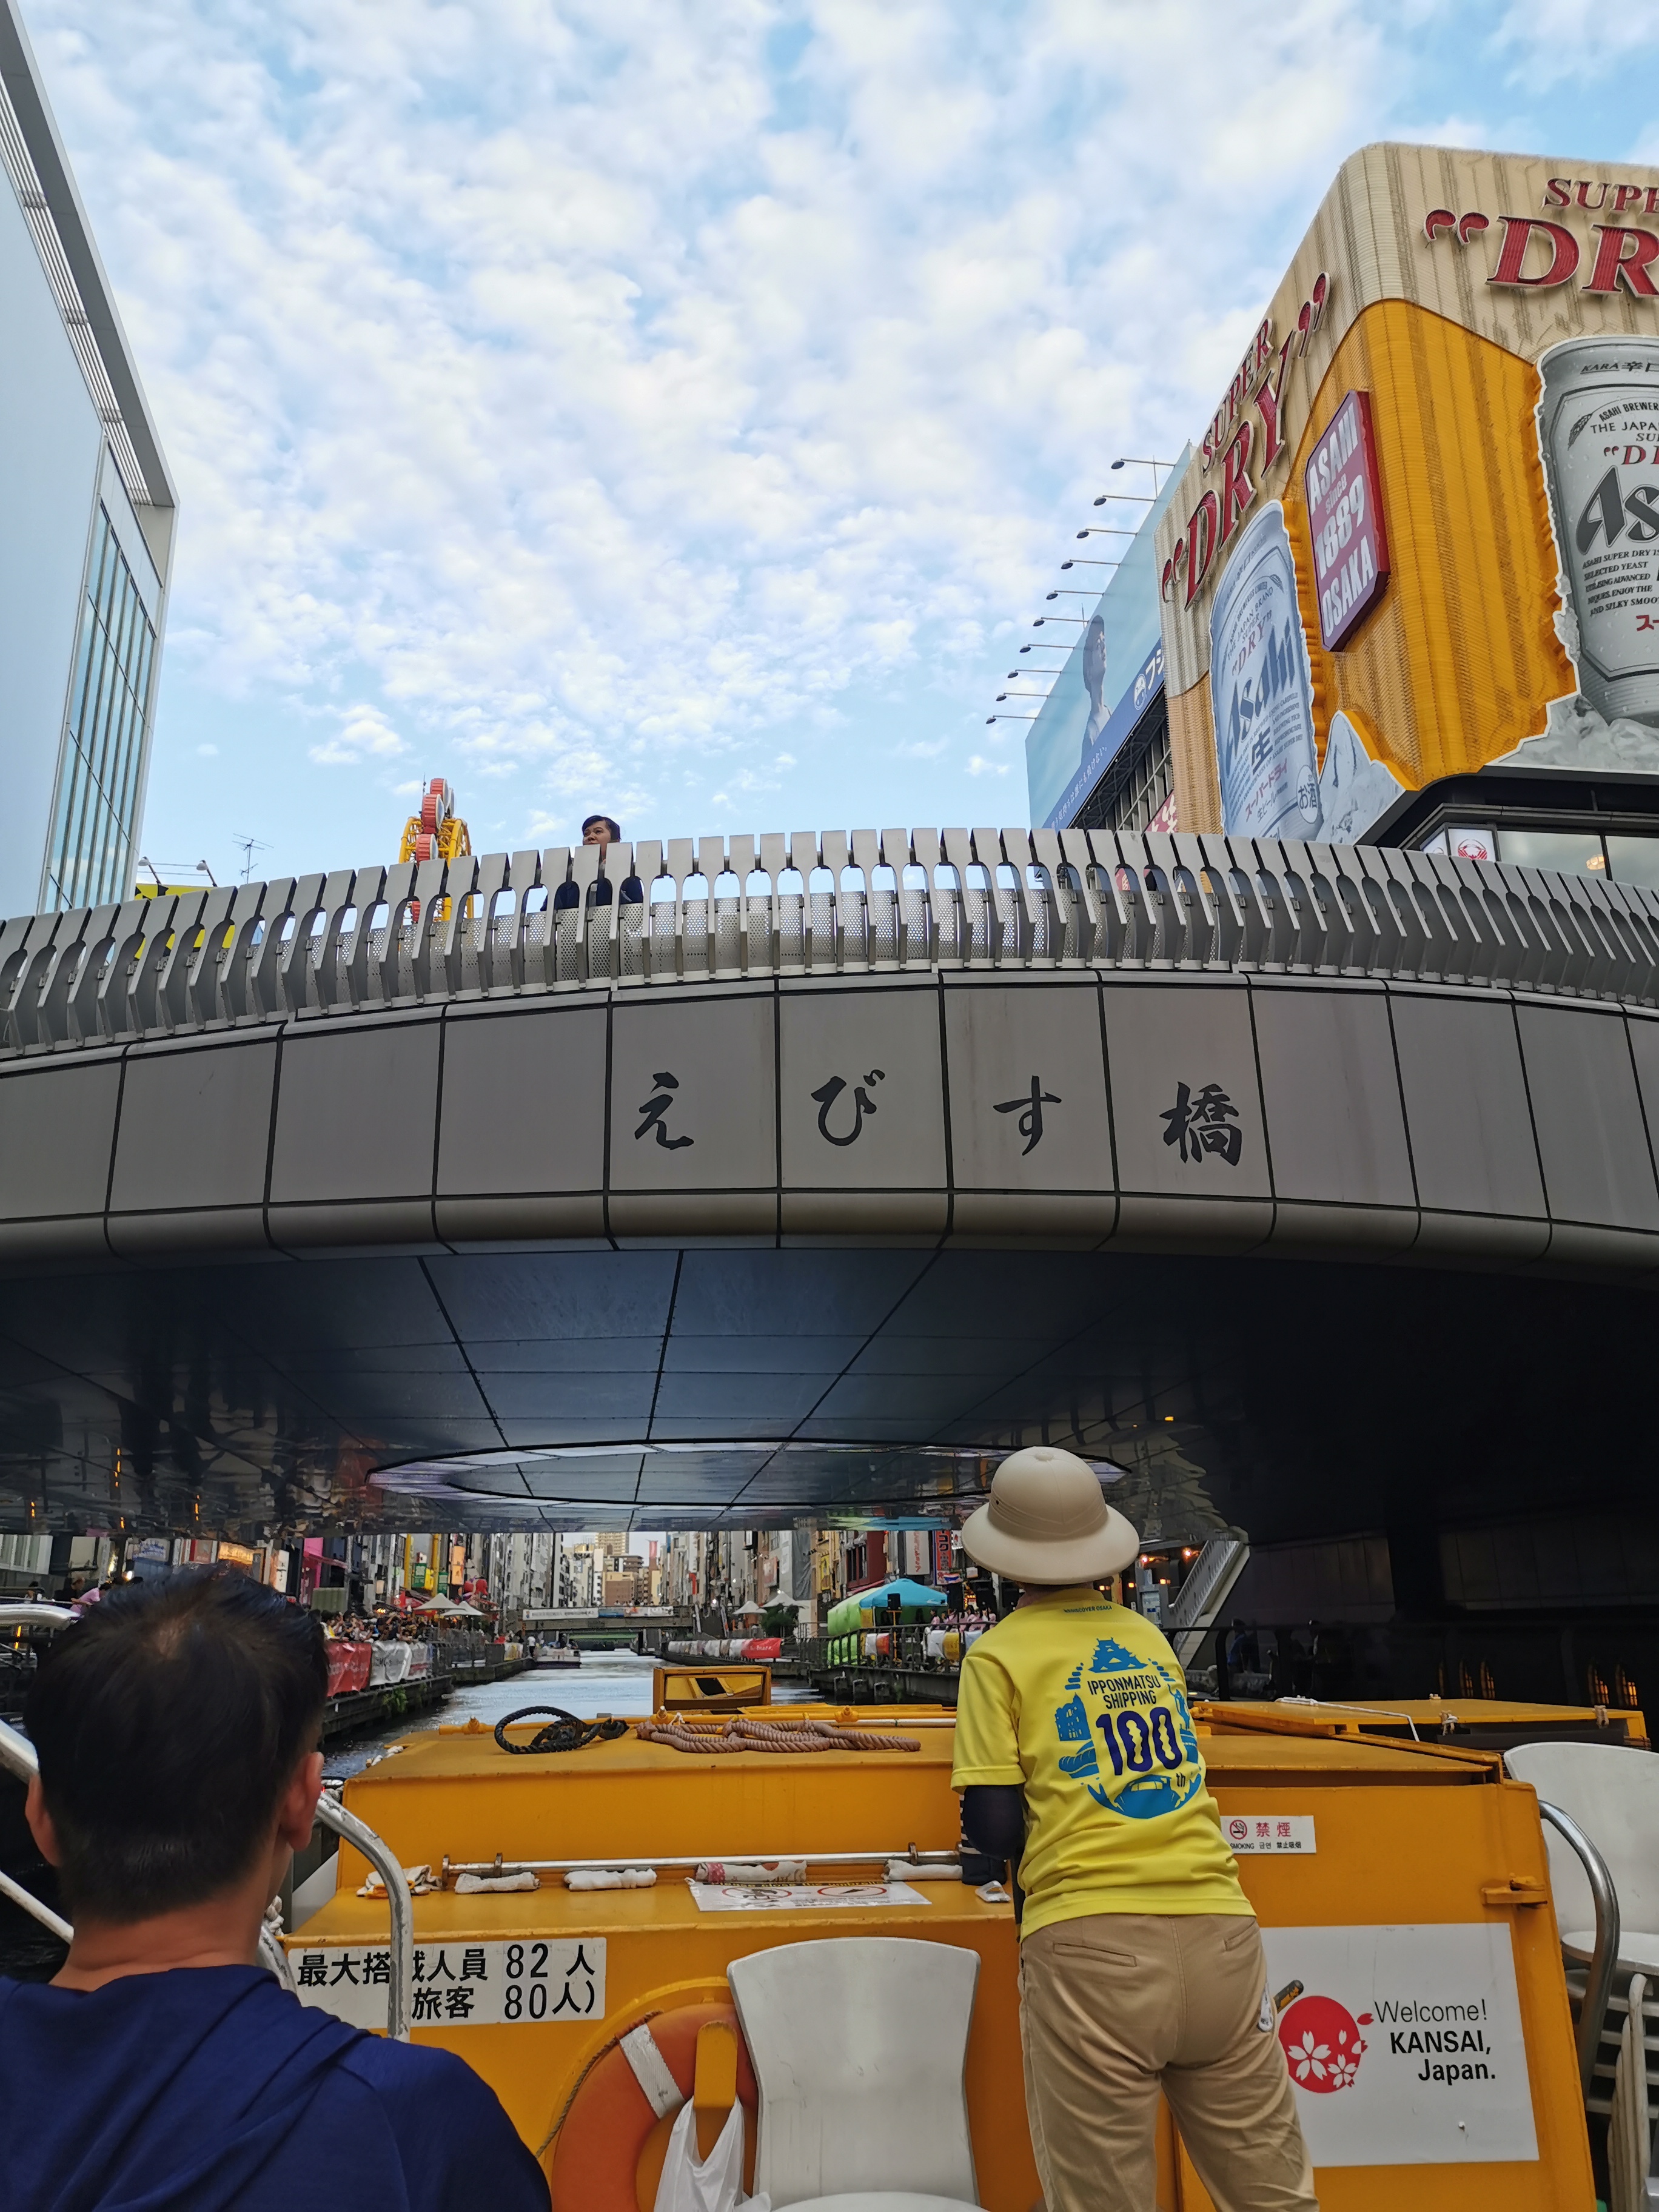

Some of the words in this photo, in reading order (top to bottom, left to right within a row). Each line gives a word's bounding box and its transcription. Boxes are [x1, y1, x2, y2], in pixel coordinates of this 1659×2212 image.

[1581, 363, 1619, 372] KARA
[1202, 318, 1273, 478] SUPER
[1598, 406, 1622, 422] ASAHI
[1590, 422, 1616, 434] THE
[1621, 421, 1659, 431] JAPA
[1635, 433, 1659, 441] SU
[1309, 401, 1358, 516] ASAHI
[1314, 474, 1365, 580] 1889
[1603, 551, 1629, 563] SUPER
[1621, 561, 1649, 571] YEAST
[1255, 586, 1273, 612] BRAND
[1321, 534, 1375, 638] OSAKA
[1612, 587, 1635, 597] ENJOY
[1605, 600, 1629, 611] SILKY
[1631, 597, 1659, 606] SMOO
[1252, 726, 1273, 775] 生
[1245, 757, 1287, 823] スーパードライ
[634, 1068, 1243, 1167] えびす橋
[1087, 1675, 1161, 1695] IPPONMATSU
[1103, 1690, 1157, 1709] SHIPPING
[1096, 1707, 1182, 1775] 100
[1256, 1822, 1292, 1837] 禁煙
[506, 1943, 549, 1979] 82
[565, 1944, 596, 1977] 人
[412, 1986, 475, 2020] 旅客
[504, 1984, 547, 2020] 80
[1374, 1999, 1487, 2023] Welcome!
[1390, 2029, 1491, 2055] KANSAI,
[1418, 2058, 1496, 2086] Japan.
